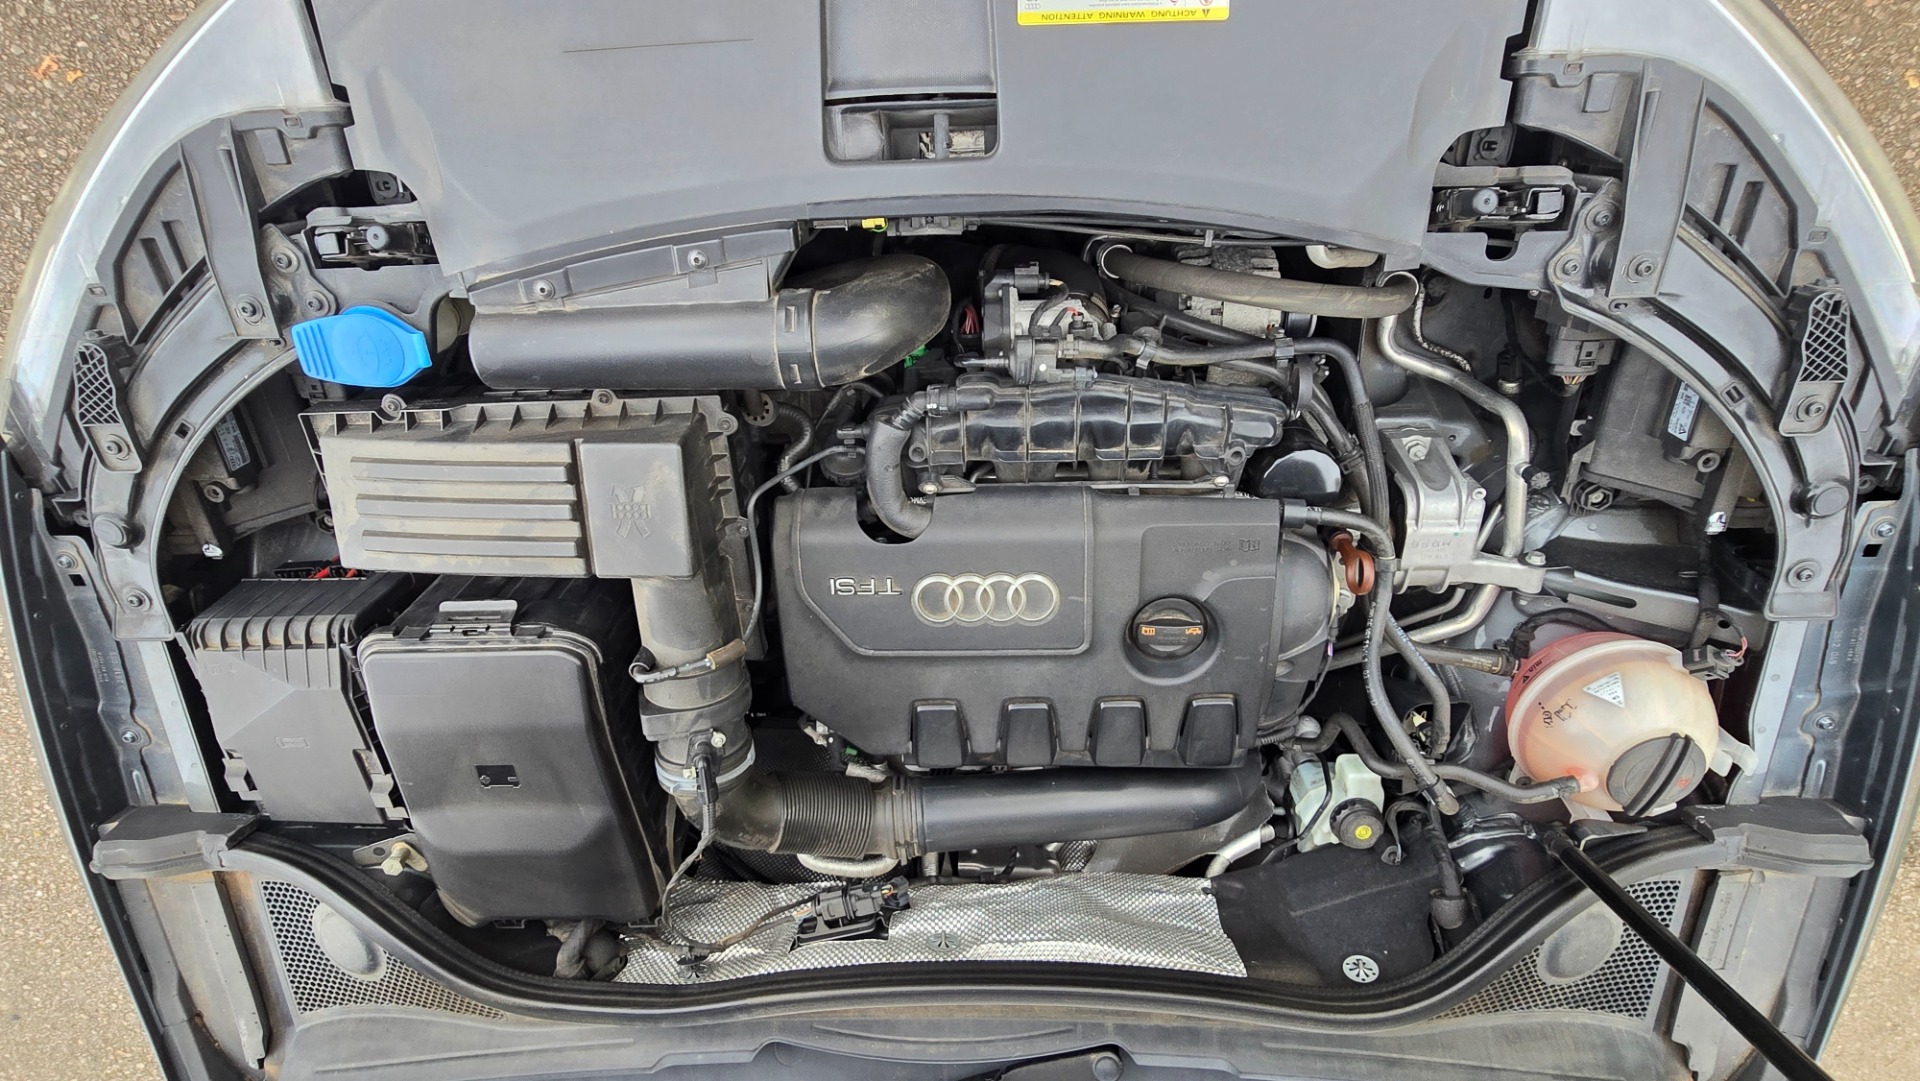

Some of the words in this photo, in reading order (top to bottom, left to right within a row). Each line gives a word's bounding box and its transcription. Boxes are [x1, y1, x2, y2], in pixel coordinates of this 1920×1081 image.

[1041, 12, 1093, 20] ATTENTION
[1099, 11, 1145, 19] WARNING
[1151, 9, 1197, 18] ACHTUNG
[829, 577, 902, 595] TFSI
[1528, 659, 1543, 672] min
